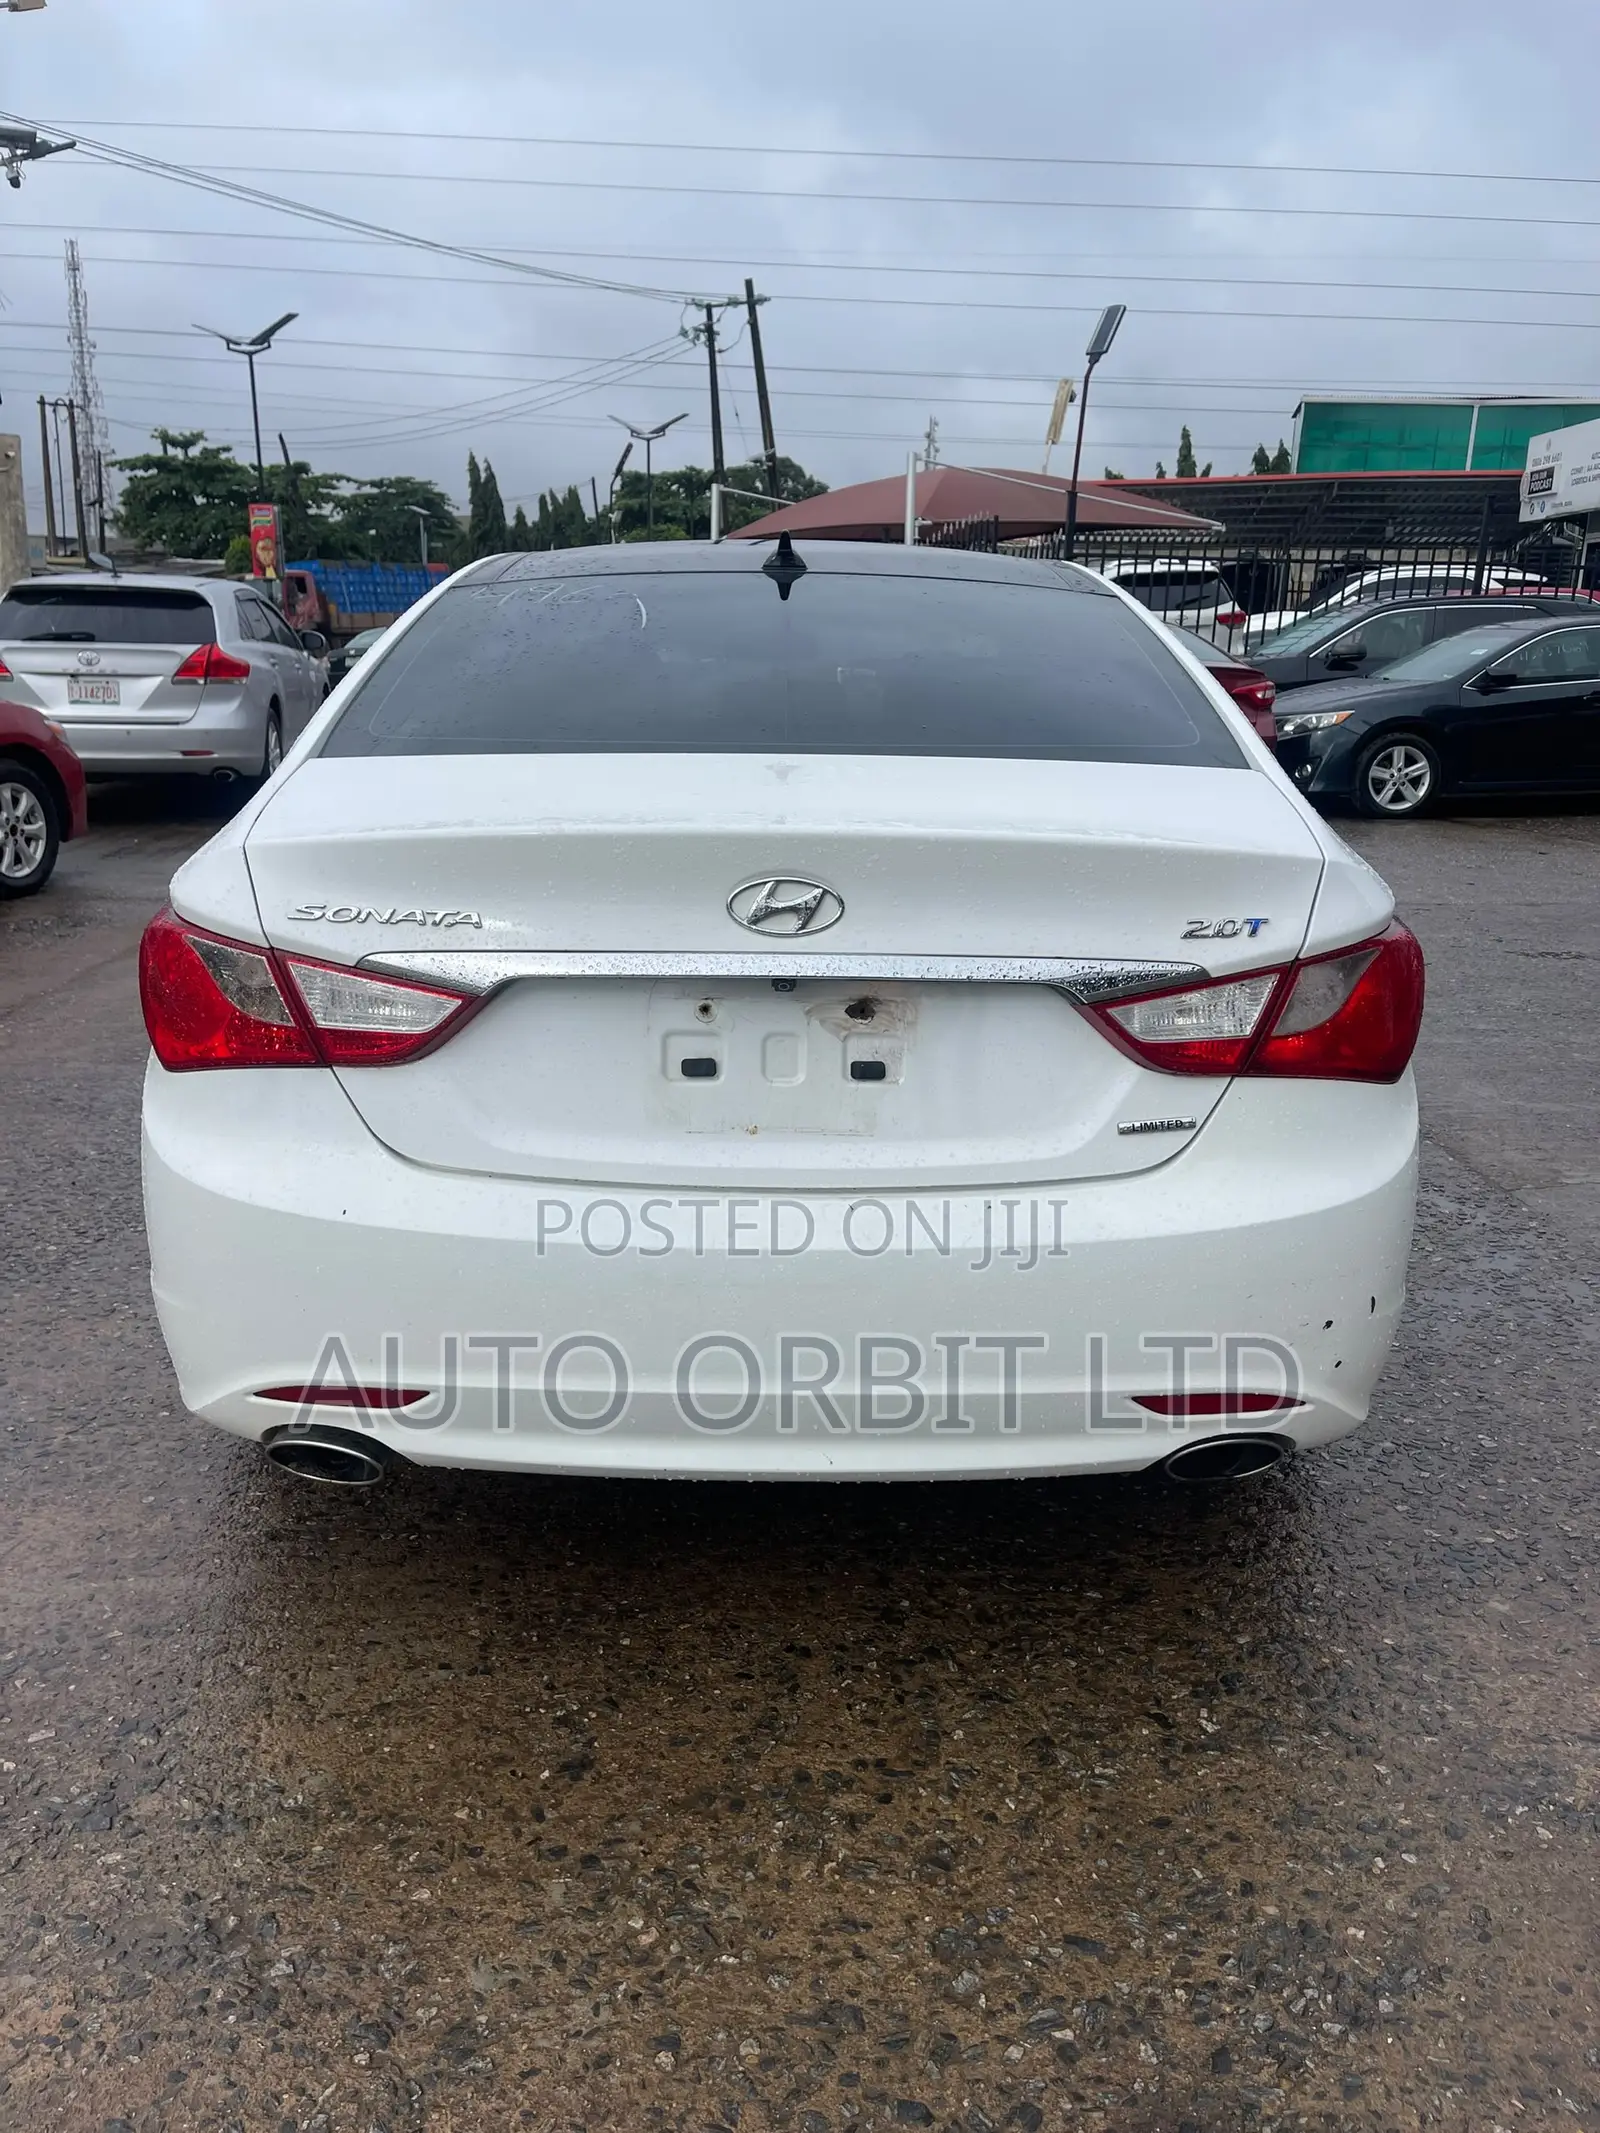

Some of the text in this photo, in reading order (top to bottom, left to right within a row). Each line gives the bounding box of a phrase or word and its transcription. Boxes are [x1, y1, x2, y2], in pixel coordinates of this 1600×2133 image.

[1529, 478, 1553, 492] PODCAST
[287, 904, 483, 929] SONATA
[1131, 1119, 1184, 1132] LIMITED
